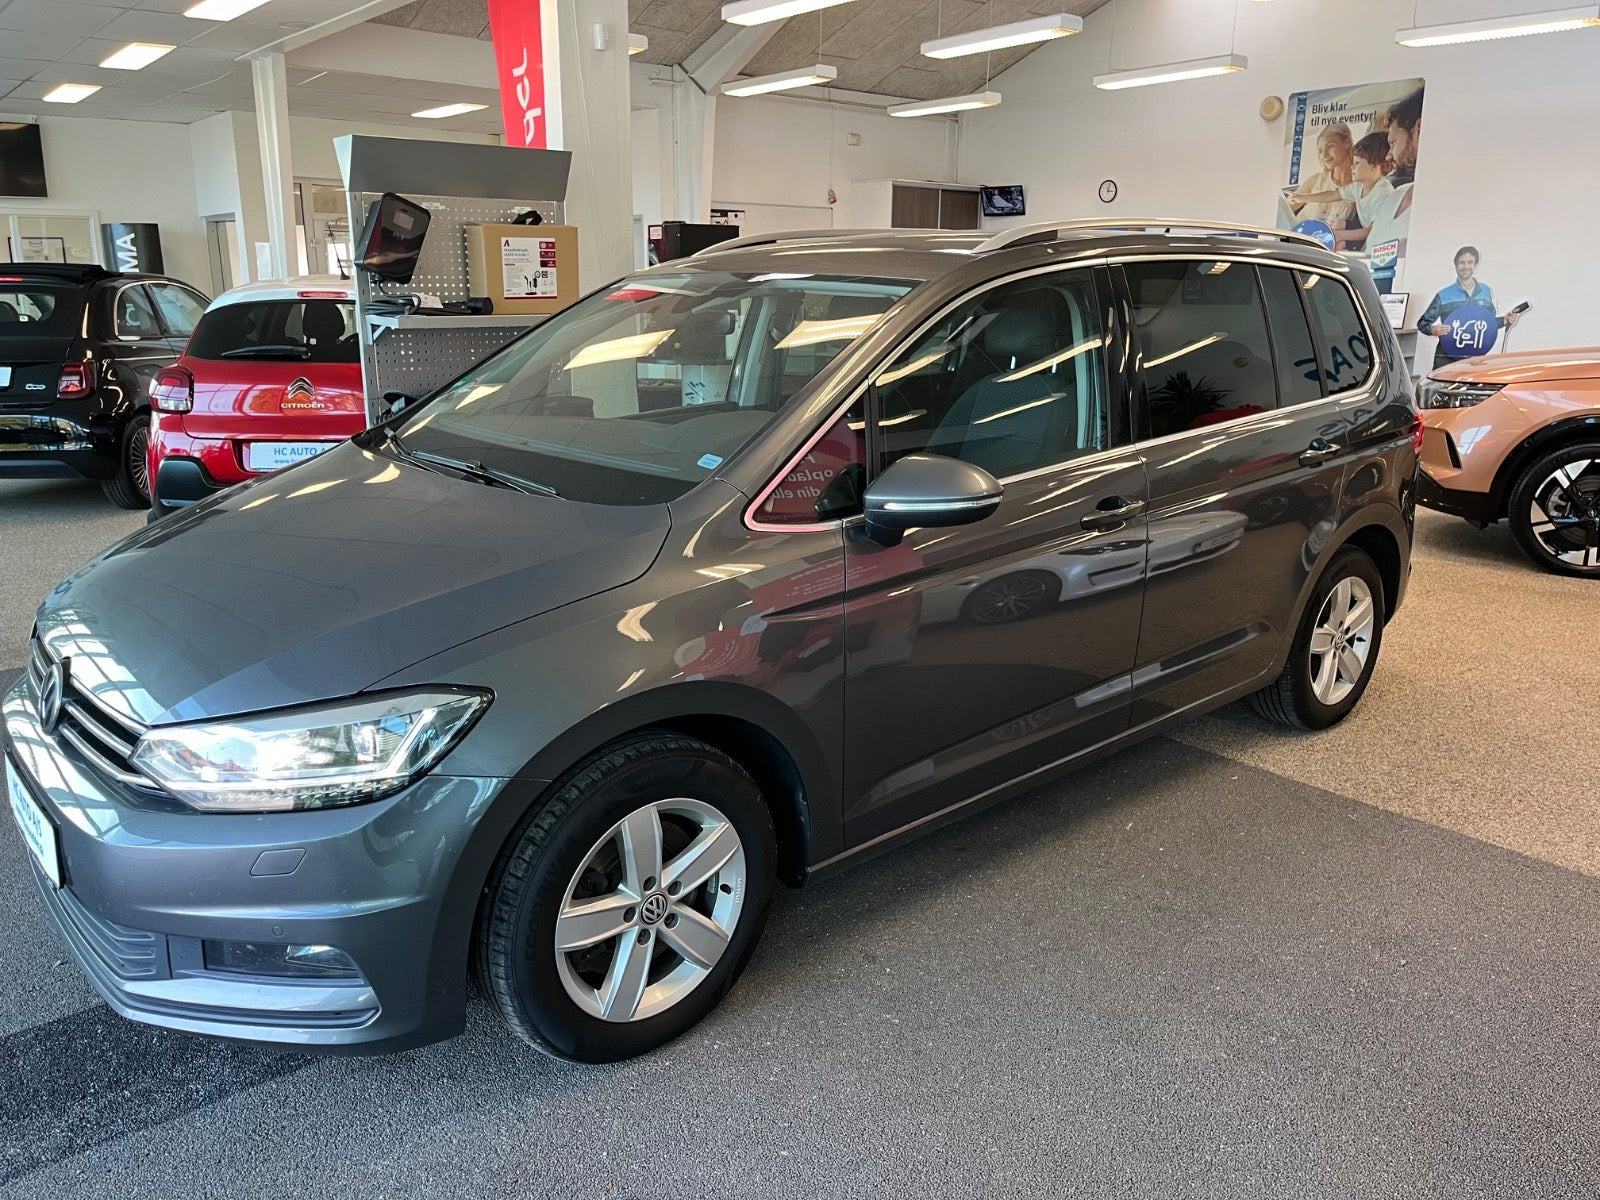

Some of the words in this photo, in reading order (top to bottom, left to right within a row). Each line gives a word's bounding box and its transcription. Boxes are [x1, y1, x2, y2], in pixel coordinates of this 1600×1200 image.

[1312, 104, 1328, 114] Bliv
[1330, 102, 1348, 113] klar
[1311, 117, 1320, 127] til
[1321, 116, 1337, 127] nye
[1339, 111, 1377, 124] eventyr!
[273, 447, 288, 456] HC
[289, 447, 317, 456] AUTO
